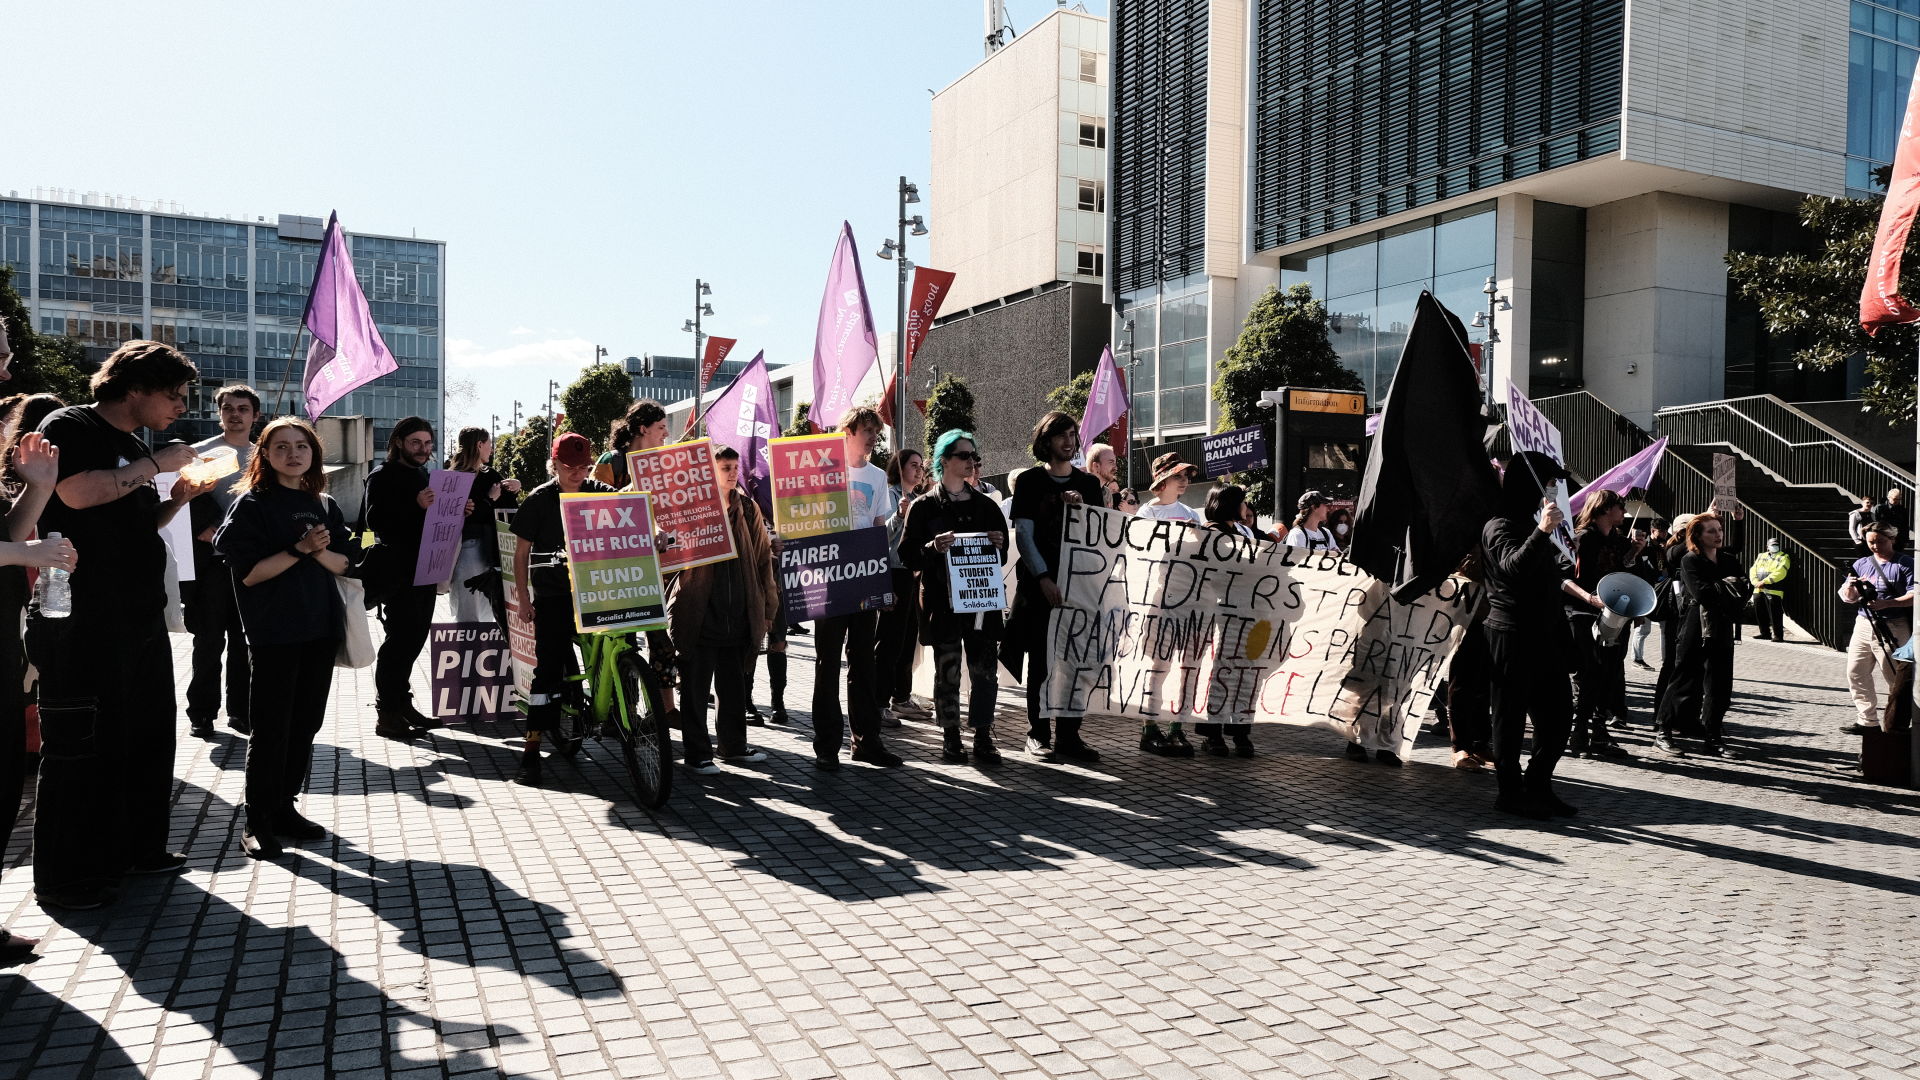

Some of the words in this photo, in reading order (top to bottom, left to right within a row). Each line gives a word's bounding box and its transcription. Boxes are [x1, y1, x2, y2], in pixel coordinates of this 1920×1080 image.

[923, 282, 940, 316] good
[1295, 396, 1338, 408] Information
[1511, 386, 1556, 454] REAL
[1203, 430, 1261, 452] WORK-LIFE
[637, 447, 708, 475] PEOPLE
[785, 447, 834, 471] TAX
[1205, 443, 1253, 462] BALANCE
[640, 465, 713, 493] BEFORE
[776, 477, 805, 491] THE
[810, 471, 846, 488] RICH
[580, 506, 636, 531] TAX
[665, 519, 677, 527] THE
[678, 510, 721, 524] BILLIONAIRES
[671, 510, 682, 519] THE
[683, 505, 712, 516] BILLIONS
[790, 500, 837, 519] FUND
[677, 524, 723, 540] Socialist
[780, 516, 849, 534] EDUCATION
[1064, 504, 1261, 564] EDUCATION
[1262, 542, 1281, 566] 4
[571, 537, 605, 554] THE
[610, 533, 651, 551] RICH
[679, 535, 724, 552] Alliance
[964, 547, 970, 555] IS
[970, 546, 982, 555] NOT
[781, 543, 840, 569] FAIRER
[952, 556, 968, 564] THEIR
[969, 554, 996, 563] BUSINESS
[590, 566, 644, 586] FUND
[784, 557, 888, 590] WORKLOADS
[959, 567, 994, 577] STUDENTS
[966, 578, 989, 588] STAND
[580, 584, 659, 604] EDUCATION
[959, 590, 978, 599] WITH
[979, 588, 999, 598] STAFF
[1064, 547, 1198, 609] PAID
[1196, 567, 1337, 614] FIRST
[1339, 588, 1453, 644] PAID
[596, 614, 623, 623] Socialist
[625, 610, 651, 619] Alliance
[434, 629, 477, 642] NTEU
[511, 634, 536, 656] CHANGE
[1325, 628, 1446, 691] PARENTAL
[1046, 664, 1166, 716] LEAVE
[1171, 666, 1304, 716] JUSTICE
[1306, 670, 1432, 742] LEAVE
